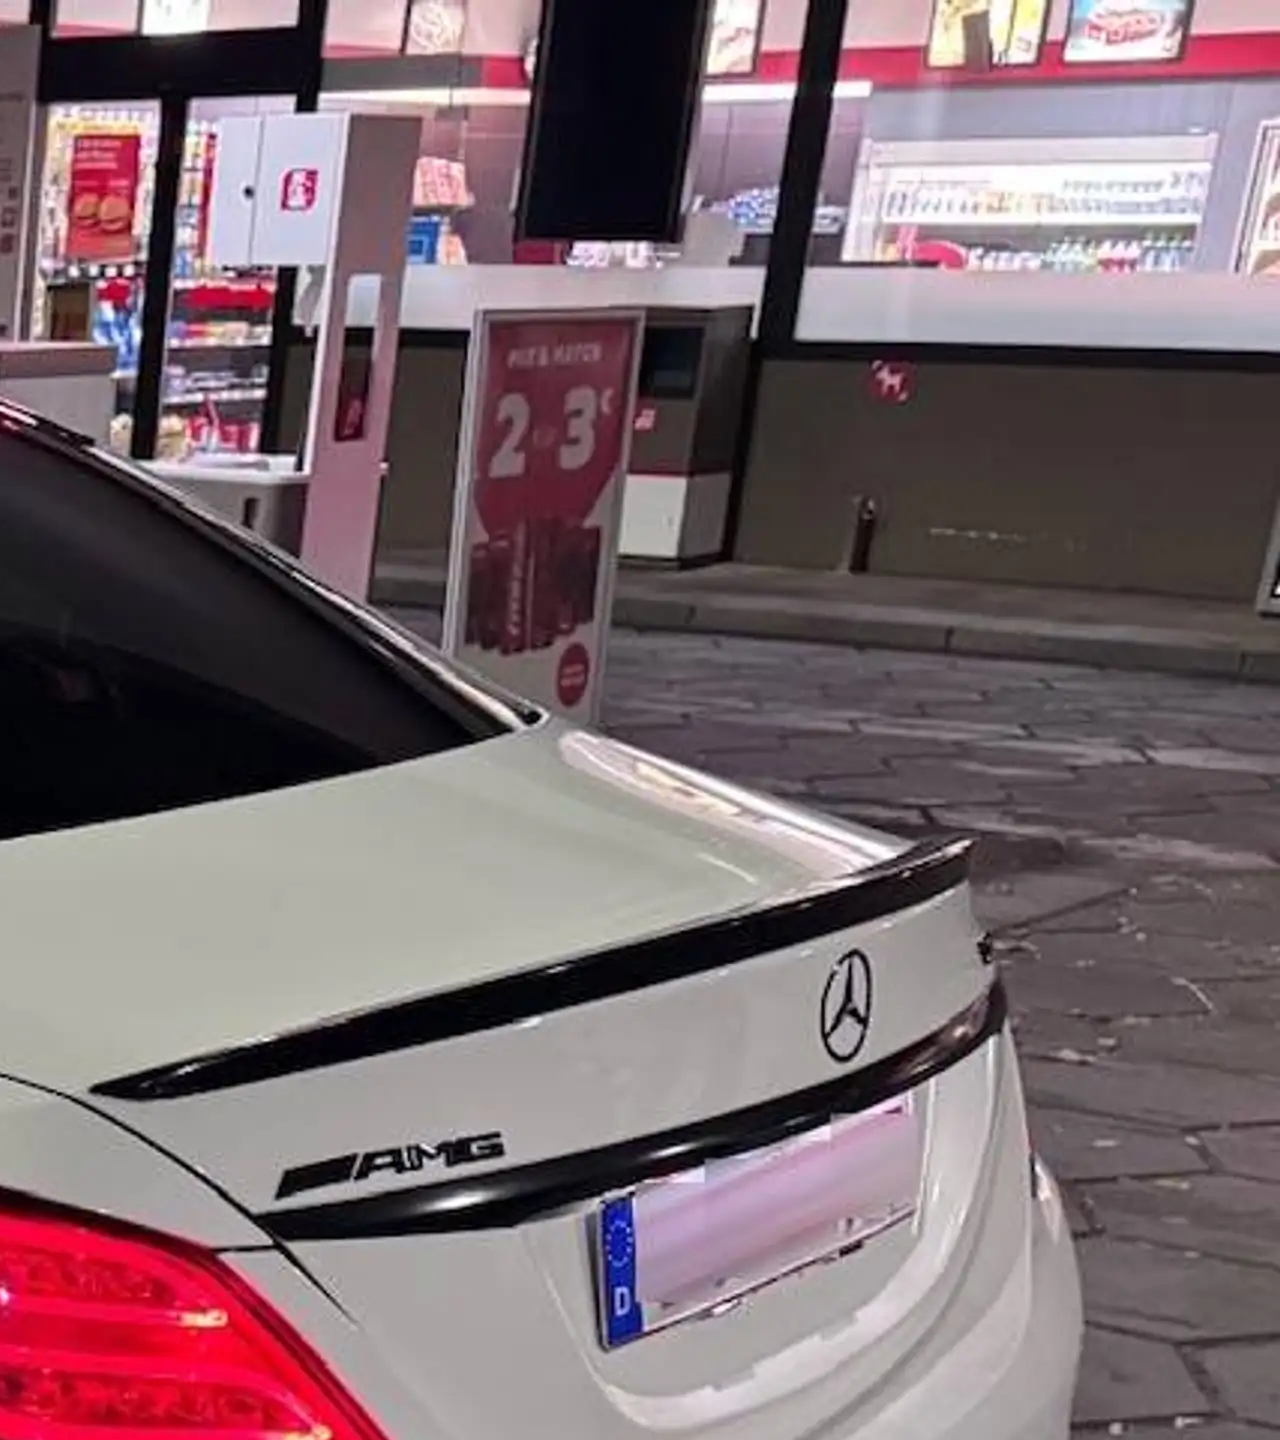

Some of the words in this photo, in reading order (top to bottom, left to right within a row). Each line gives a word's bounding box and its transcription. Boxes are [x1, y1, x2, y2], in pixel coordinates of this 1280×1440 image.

[488, 392, 531, 479] 2
[353, 1131, 506, 1181] AMG
[613, 1286, 632, 1317] D
